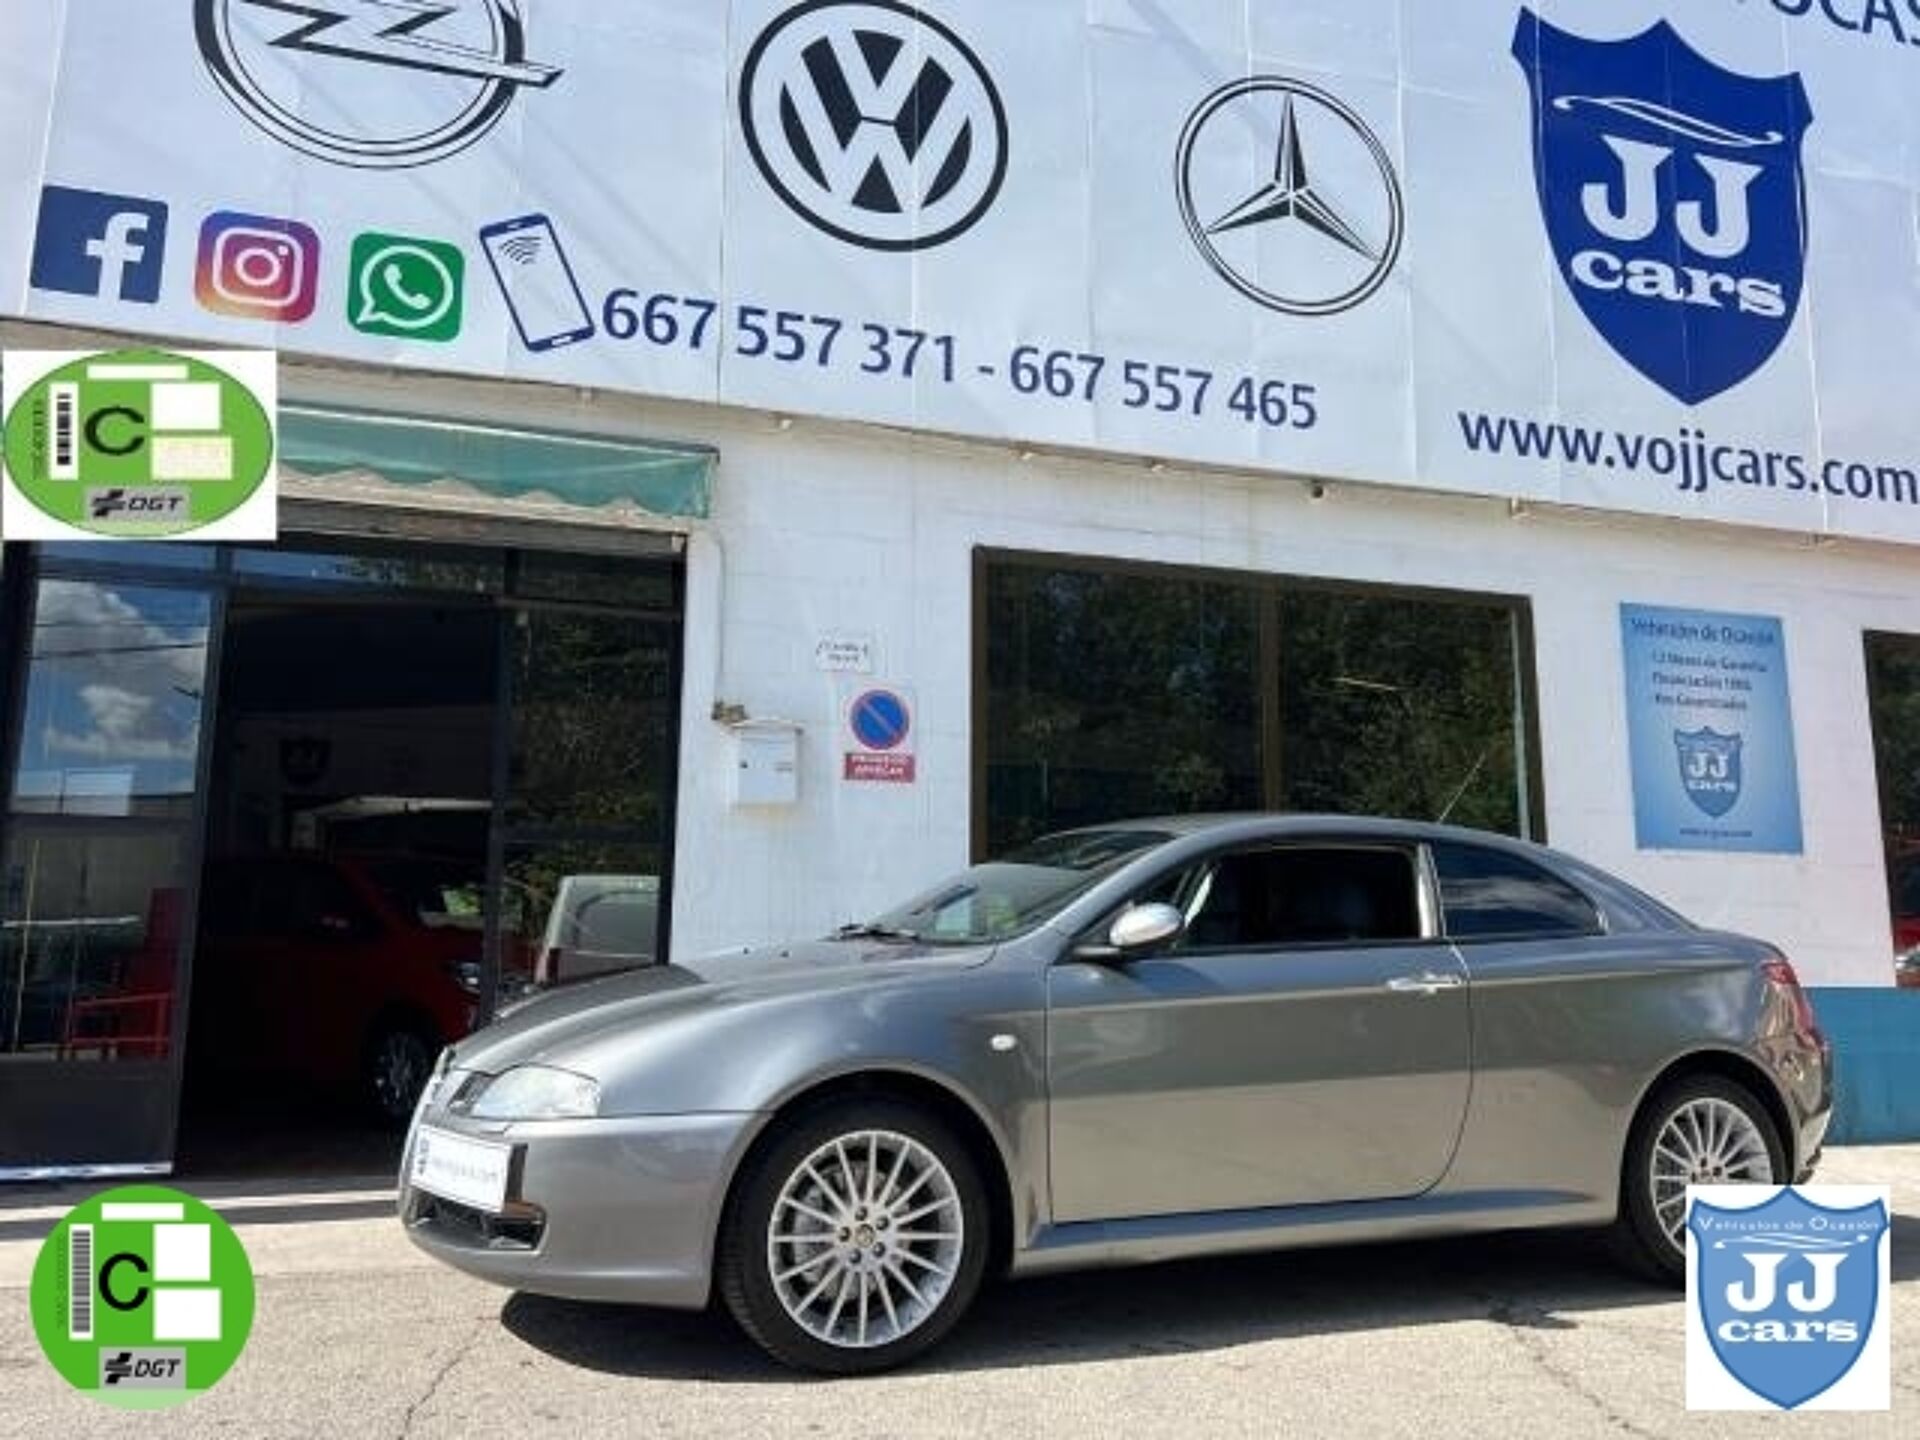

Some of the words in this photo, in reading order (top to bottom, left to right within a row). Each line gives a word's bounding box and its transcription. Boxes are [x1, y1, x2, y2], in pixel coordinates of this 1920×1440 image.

[1581, 134, 1765, 259] JJ
[1571, 250, 1786, 318] cars
[602, 288, 717, 349] 667
[736, 306, 841, 366] 557
[860, 323, 955, 382] 371
[978, 364, 994, 375] -
[1010, 346, 1105, 402] 667
[1123, 361, 1212, 415] 557
[1228, 377, 1317, 429] 465
[1458, 411, 1918, 505] www.vojjcars.com
[1688, 753, 1729, 778] JJ
